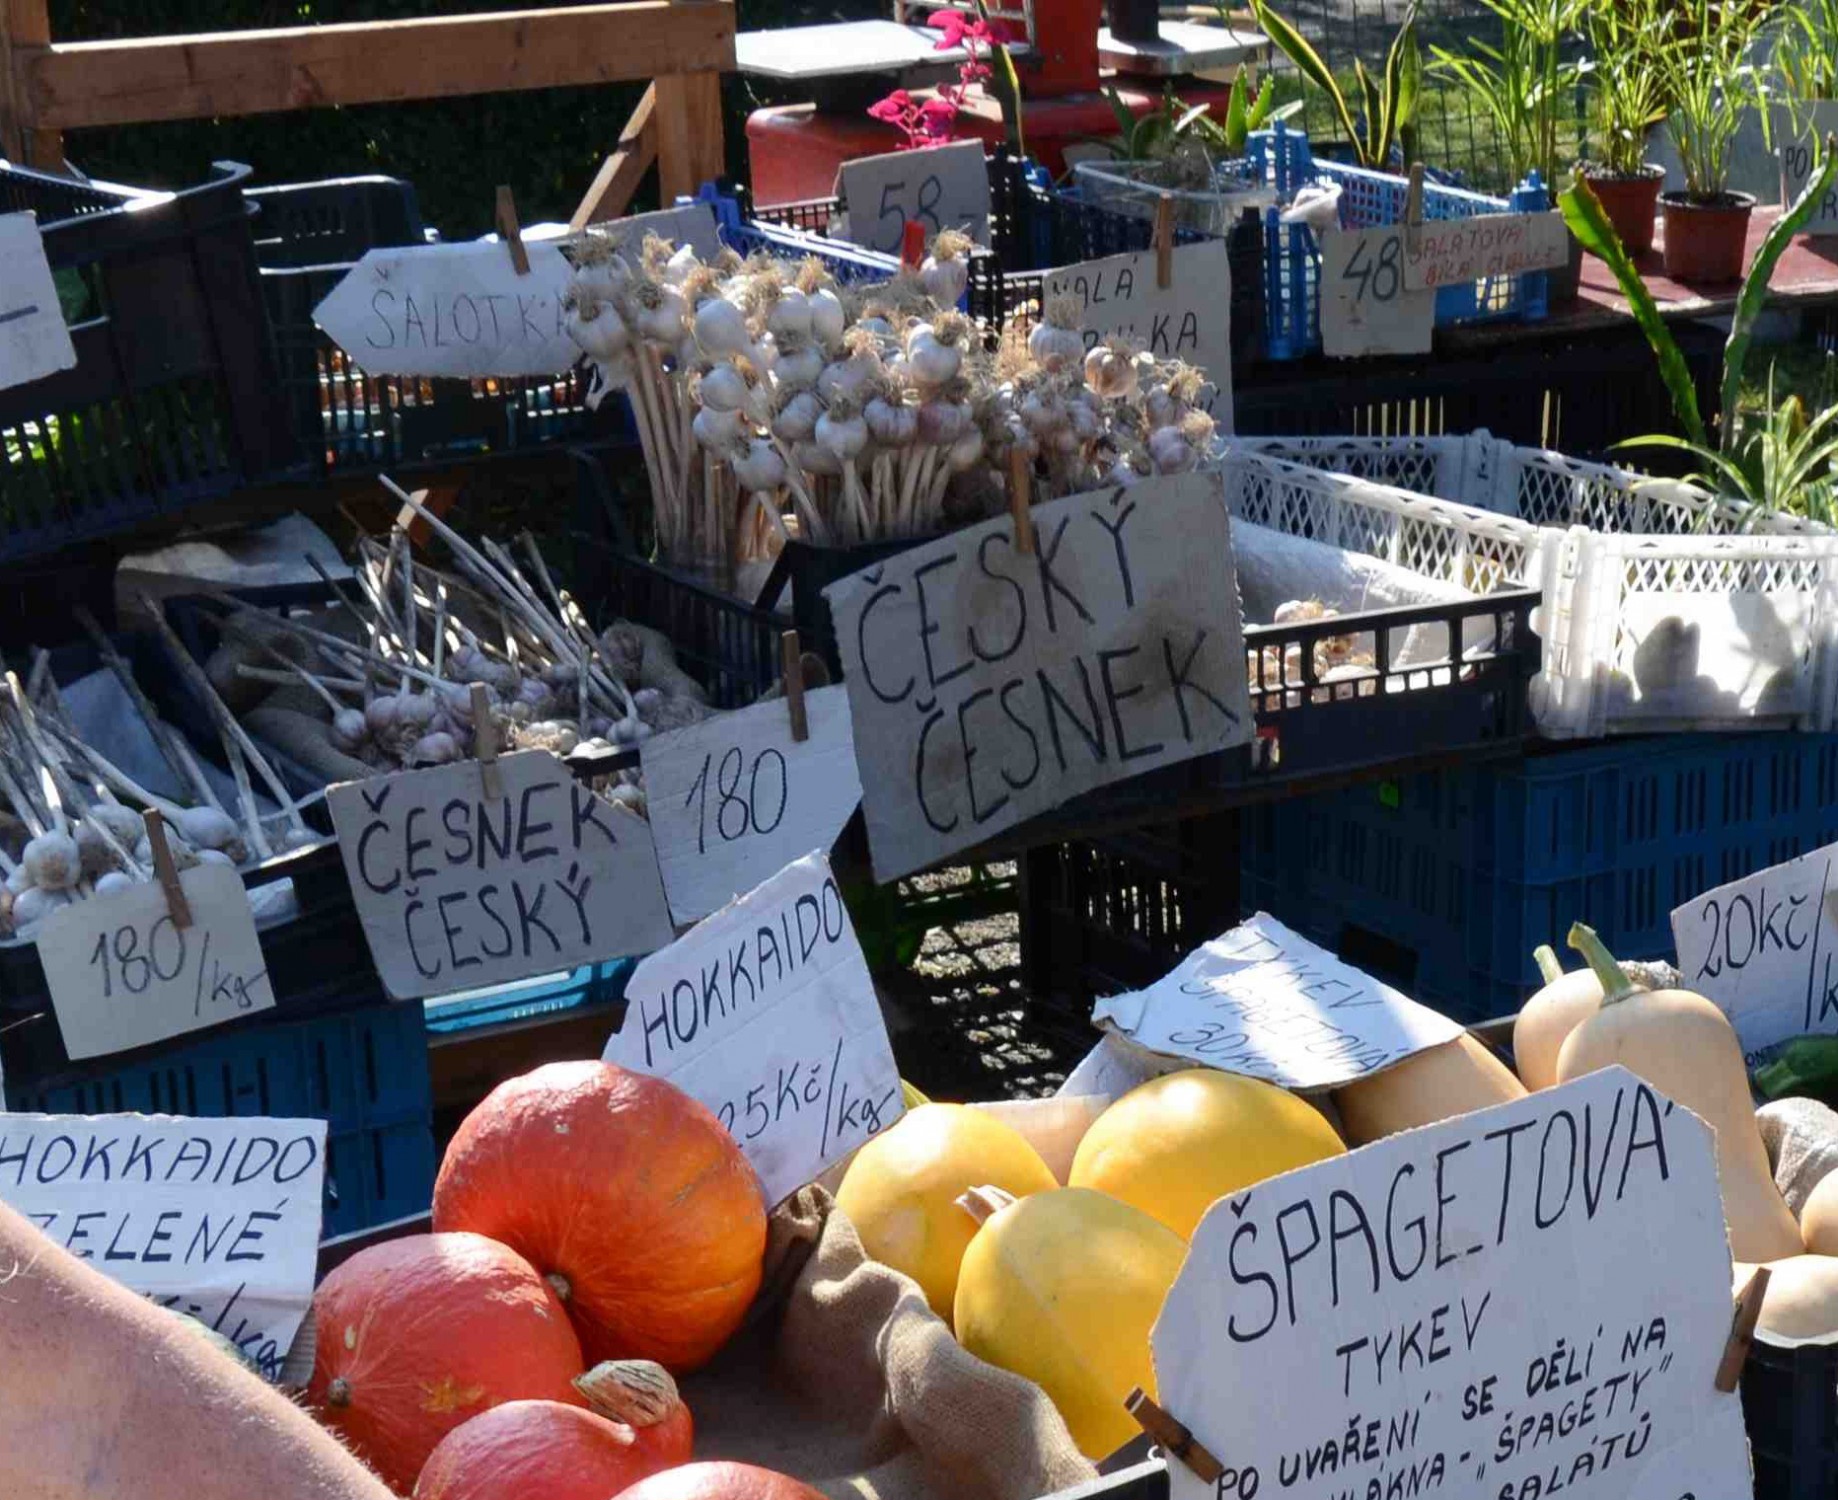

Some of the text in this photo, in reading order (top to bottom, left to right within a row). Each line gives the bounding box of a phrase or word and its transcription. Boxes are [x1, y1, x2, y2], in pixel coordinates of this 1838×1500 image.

[858, 487, 1136, 703] ČESKÝ
[683, 746, 788, 855] 180
[915, 628, 1241, 835] ČESNEK
[356, 782, 618, 895] ČESNEK
[403, 861, 593, 980] ČESKÝ
[639, 876, 844, 1067] HOKKAIDO
[0, 1133, 318, 1187] HOKKAIDO
[1226, 1083, 1676, 1343] ŠPAGETOVÁ
[1277, 1389, 1432, 1489] UVAŘENÍ
[1461, 1373, 1498, 1421] SE
[1525, 1323, 1604, 1399] DĚLÍ
[1621, 1316, 1668, 1363] NA
[1335, 1290, 1492, 1398] TYKEV
